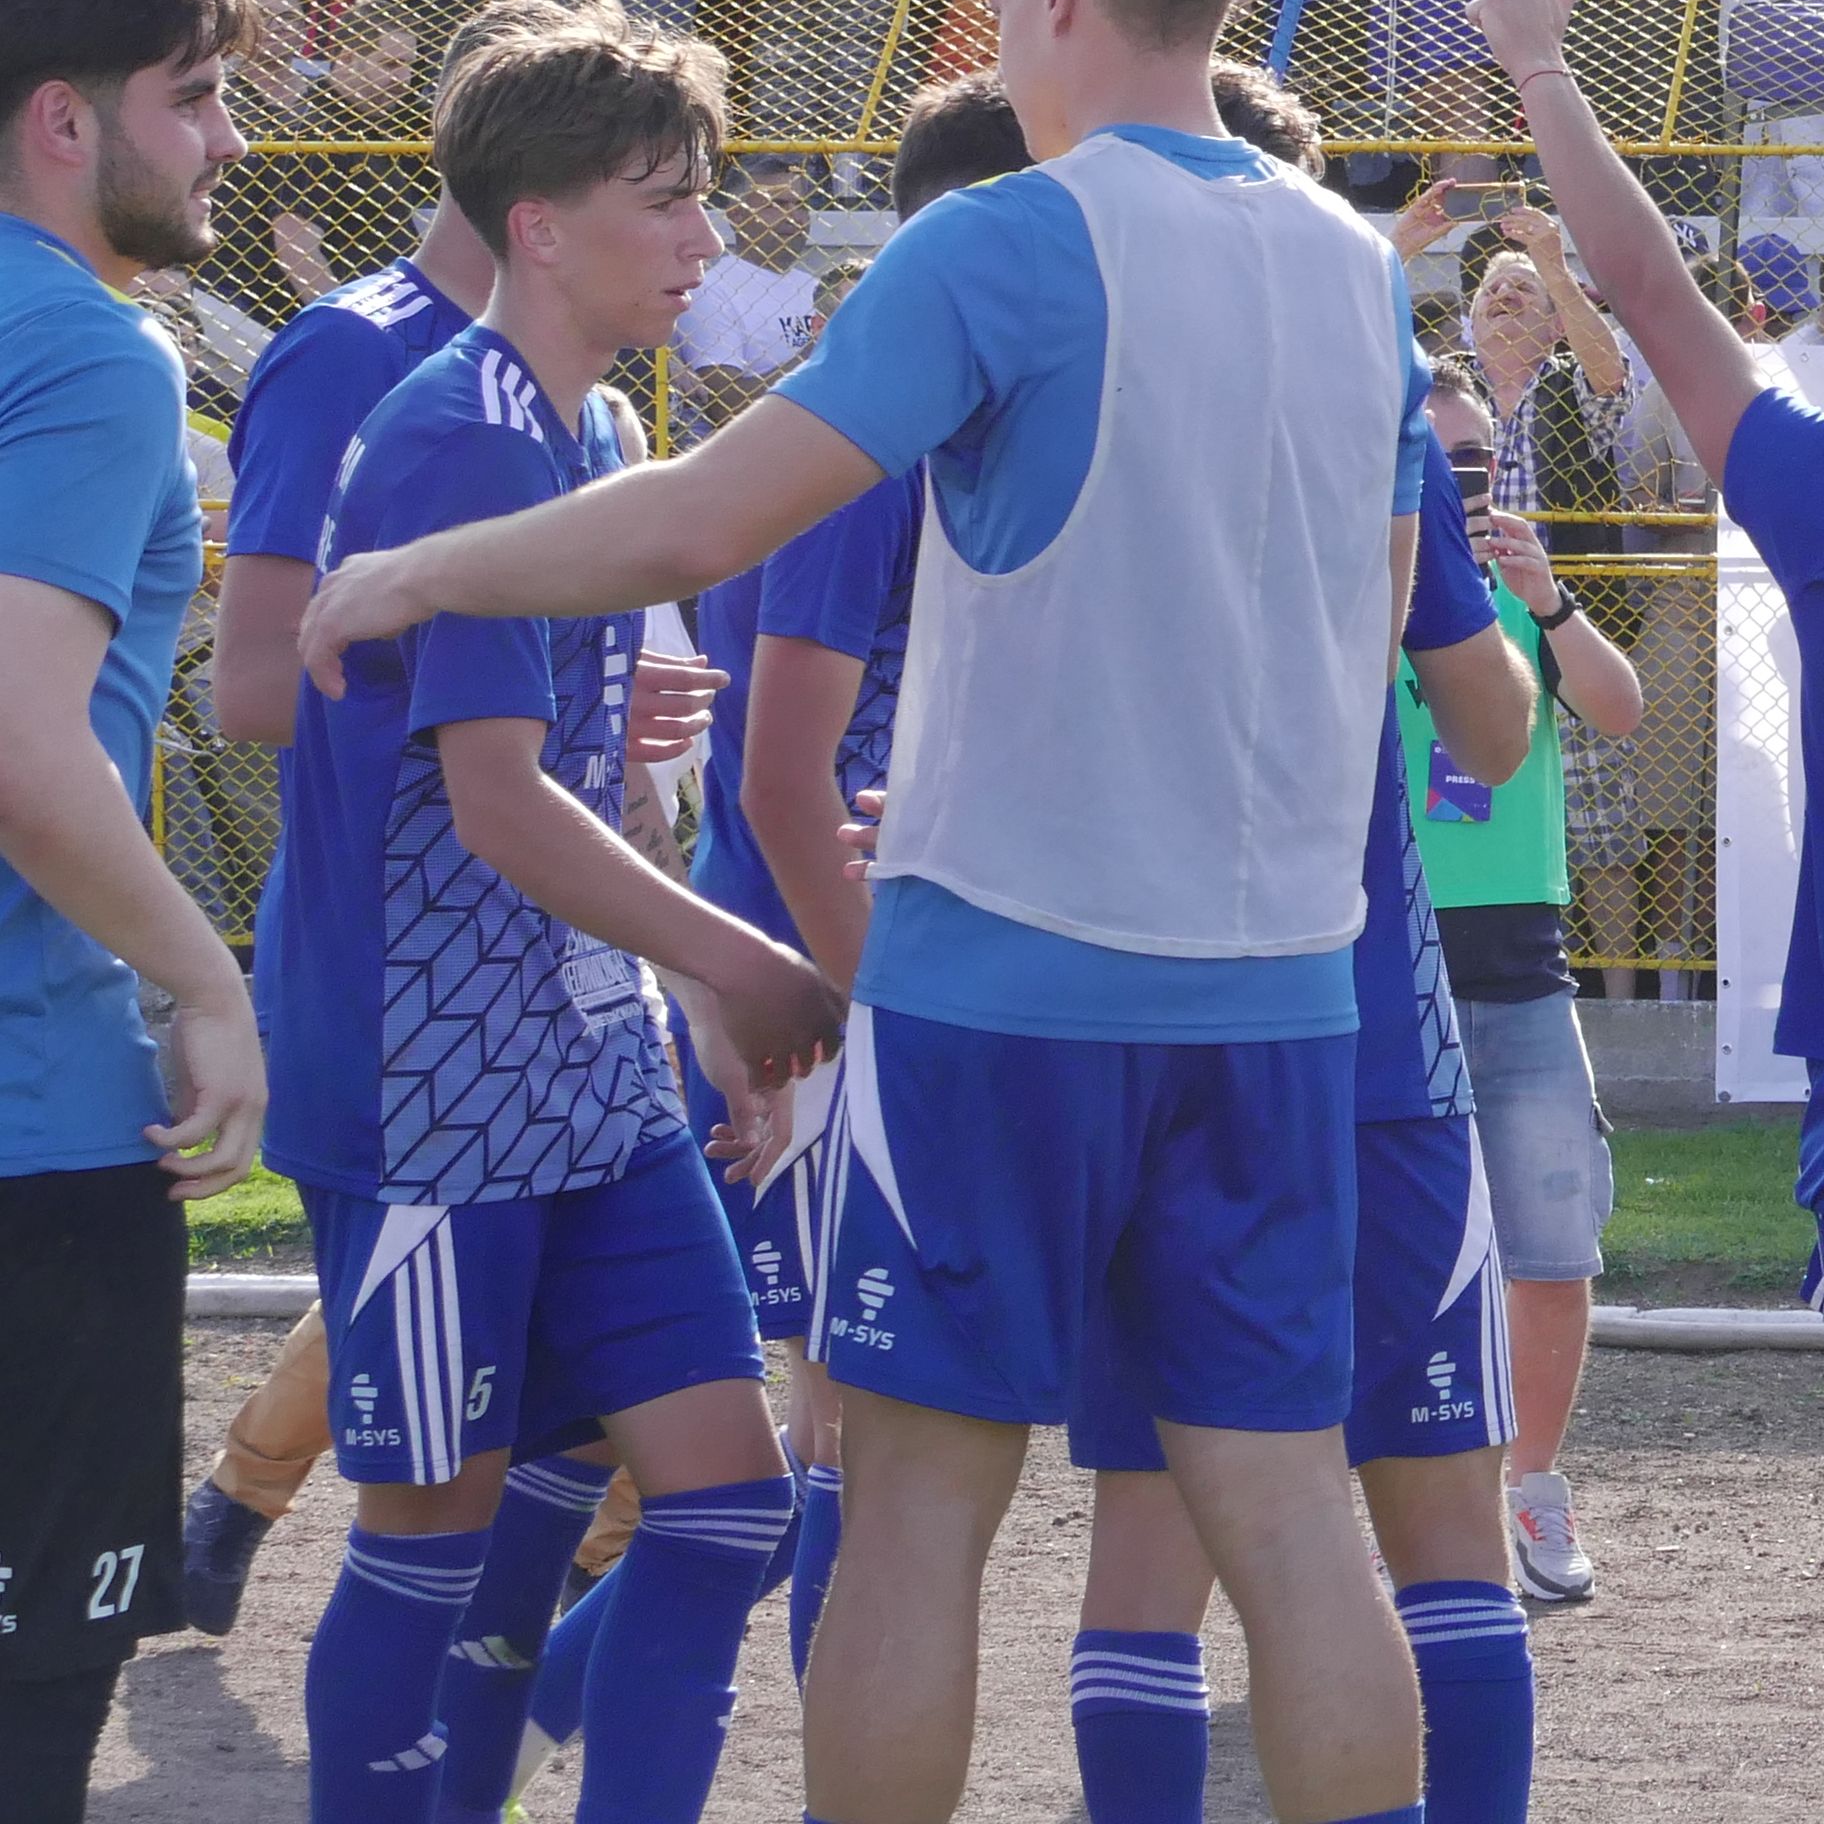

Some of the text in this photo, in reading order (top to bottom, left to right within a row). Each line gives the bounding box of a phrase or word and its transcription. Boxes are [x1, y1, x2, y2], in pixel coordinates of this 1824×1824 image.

[829, 1316, 897, 1351] M-SYS
[465, 1365, 497, 1422] 5
[1410, 1400, 1475, 1424] M-SYS
[345, 1427, 402, 1447] M-SYS
[87, 1544, 146, 1620] 27
